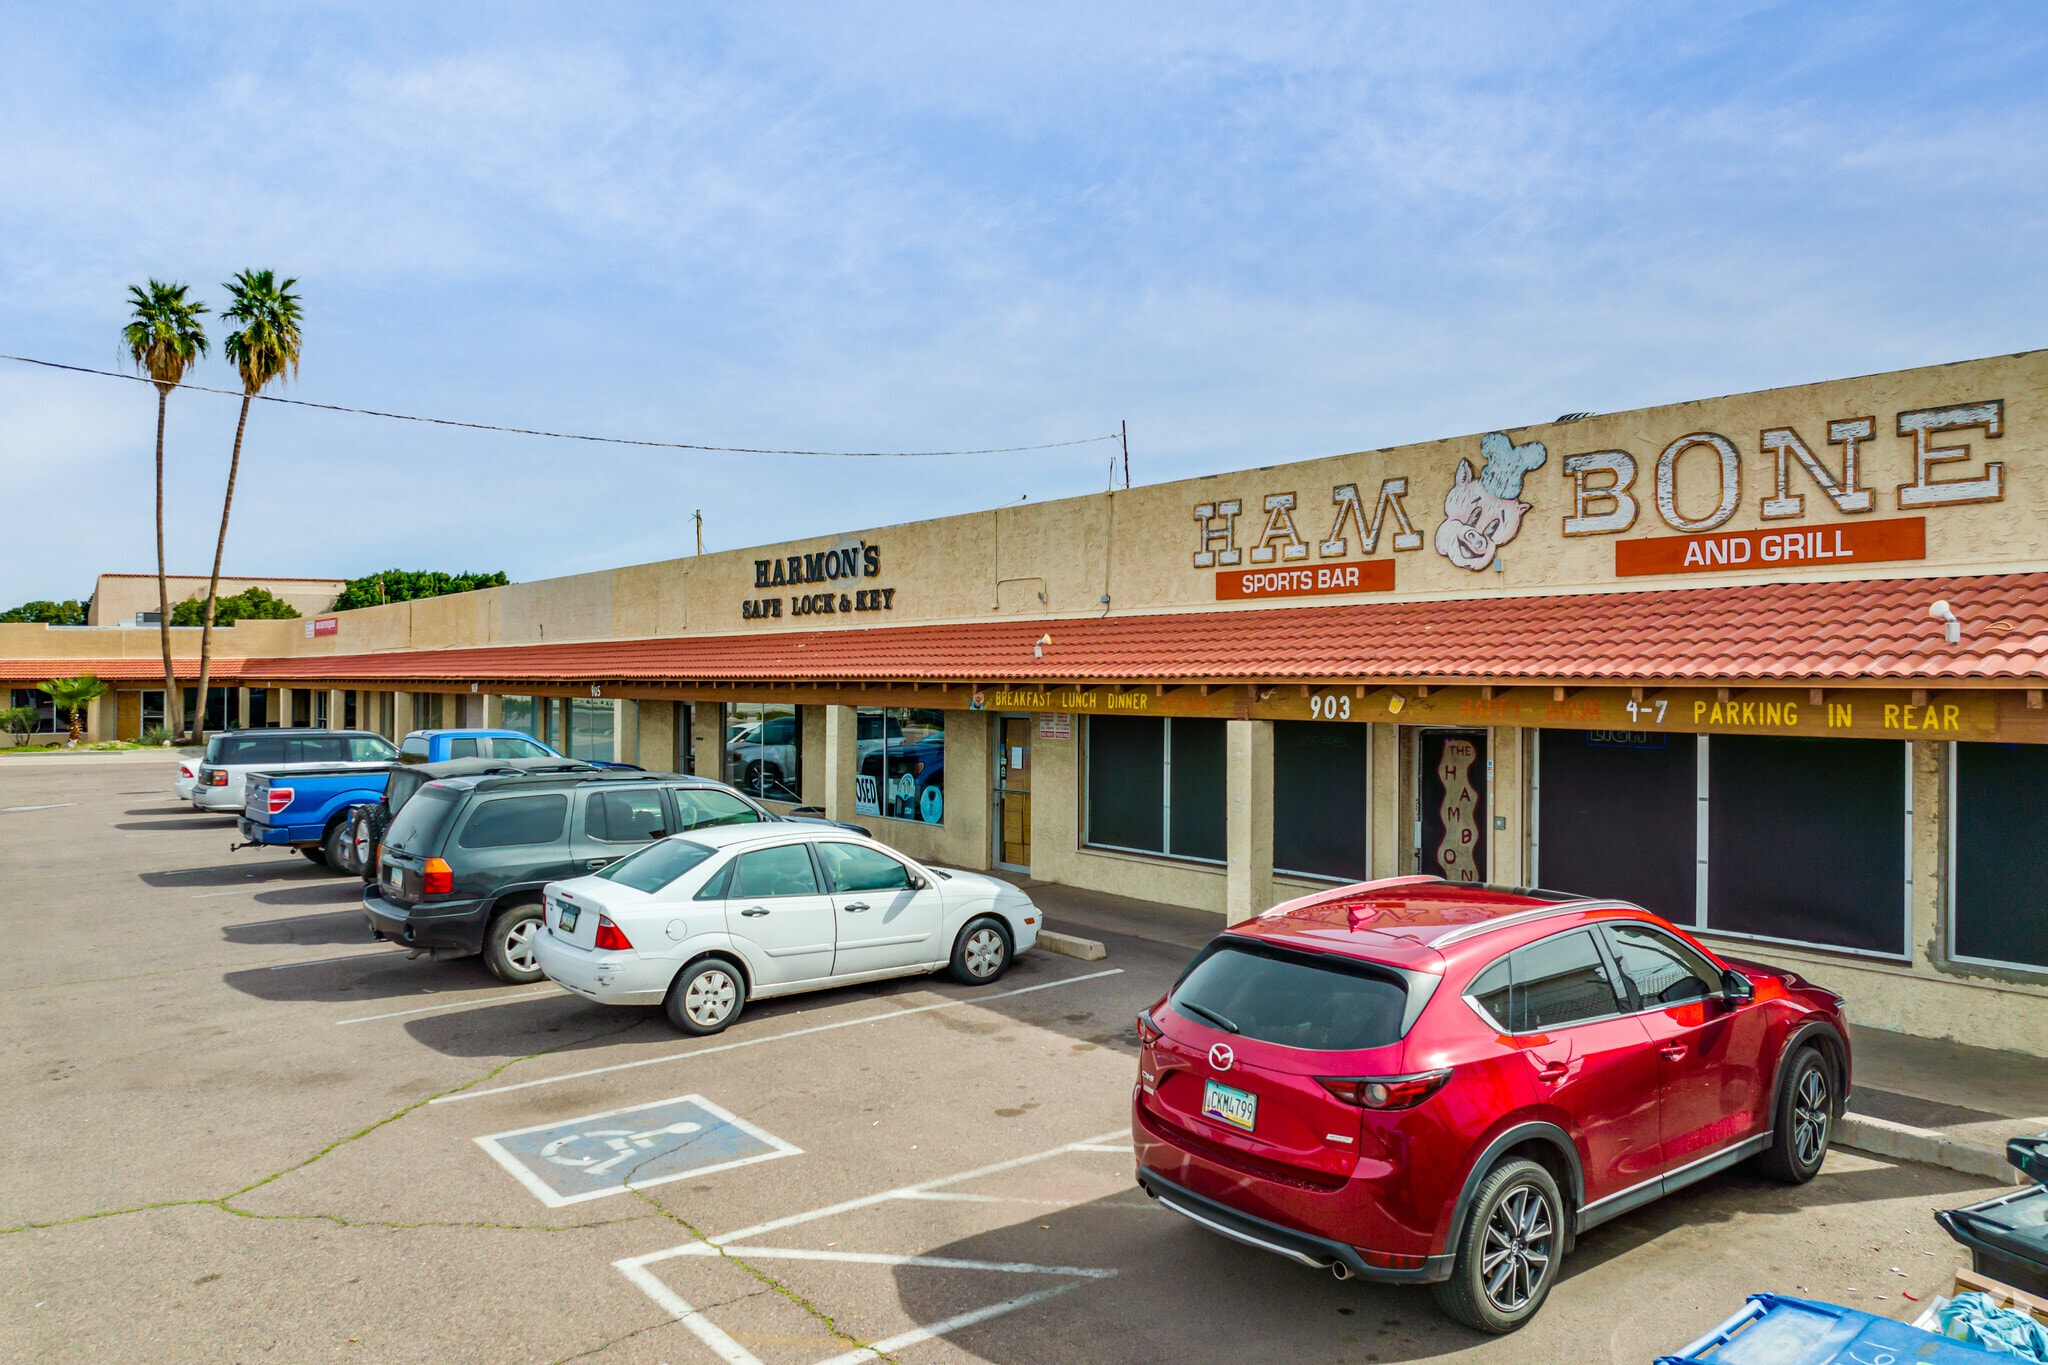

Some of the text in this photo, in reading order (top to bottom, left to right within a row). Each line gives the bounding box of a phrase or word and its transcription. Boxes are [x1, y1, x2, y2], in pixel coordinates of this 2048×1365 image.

[1193, 398, 2004, 568] HAM BONE
[1683, 529, 1854, 567] AND GRILL
[754, 539, 882, 588] HARMON'S
[1242, 567, 1360, 594] SPORTS BAR
[742, 588, 895, 619] SAFE LOCK & KEY
[995, 691, 1051, 707] BREAKFAST
[1062, 692, 1097, 709] LUNCH
[1107, 693, 1148, 710] DINNER
[1310, 695, 1351, 720] 903
[1460, 699, 1668, 723] HAPPY HOUR 4-7
[1694, 701, 1960, 731] PARKING IN REAR
[1448, 745, 1472, 757] THE
[1210, 1091, 1254, 1121] CKM4799
